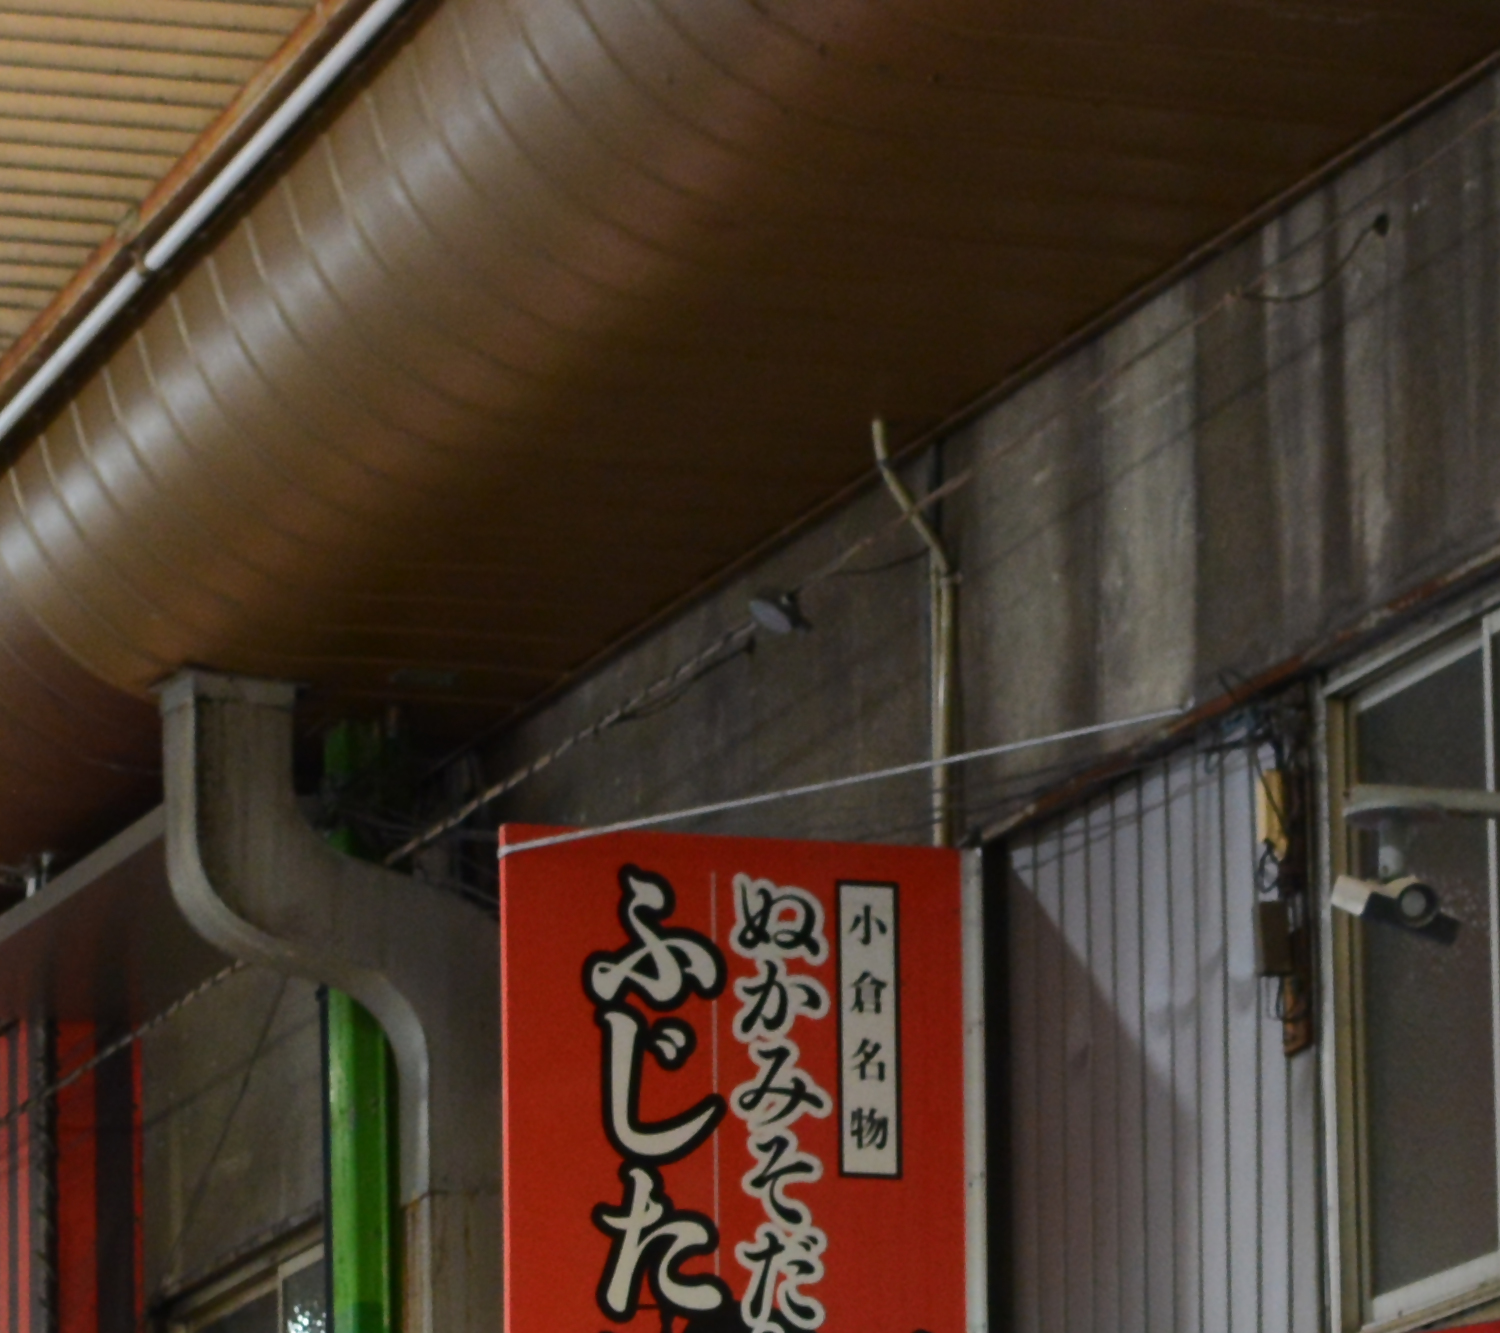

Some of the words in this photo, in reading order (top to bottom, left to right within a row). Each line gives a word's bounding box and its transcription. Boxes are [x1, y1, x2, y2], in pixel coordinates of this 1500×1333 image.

[584, 862, 730, 1315] ふじた
[847, 903, 889, 1152] 小倉名物
